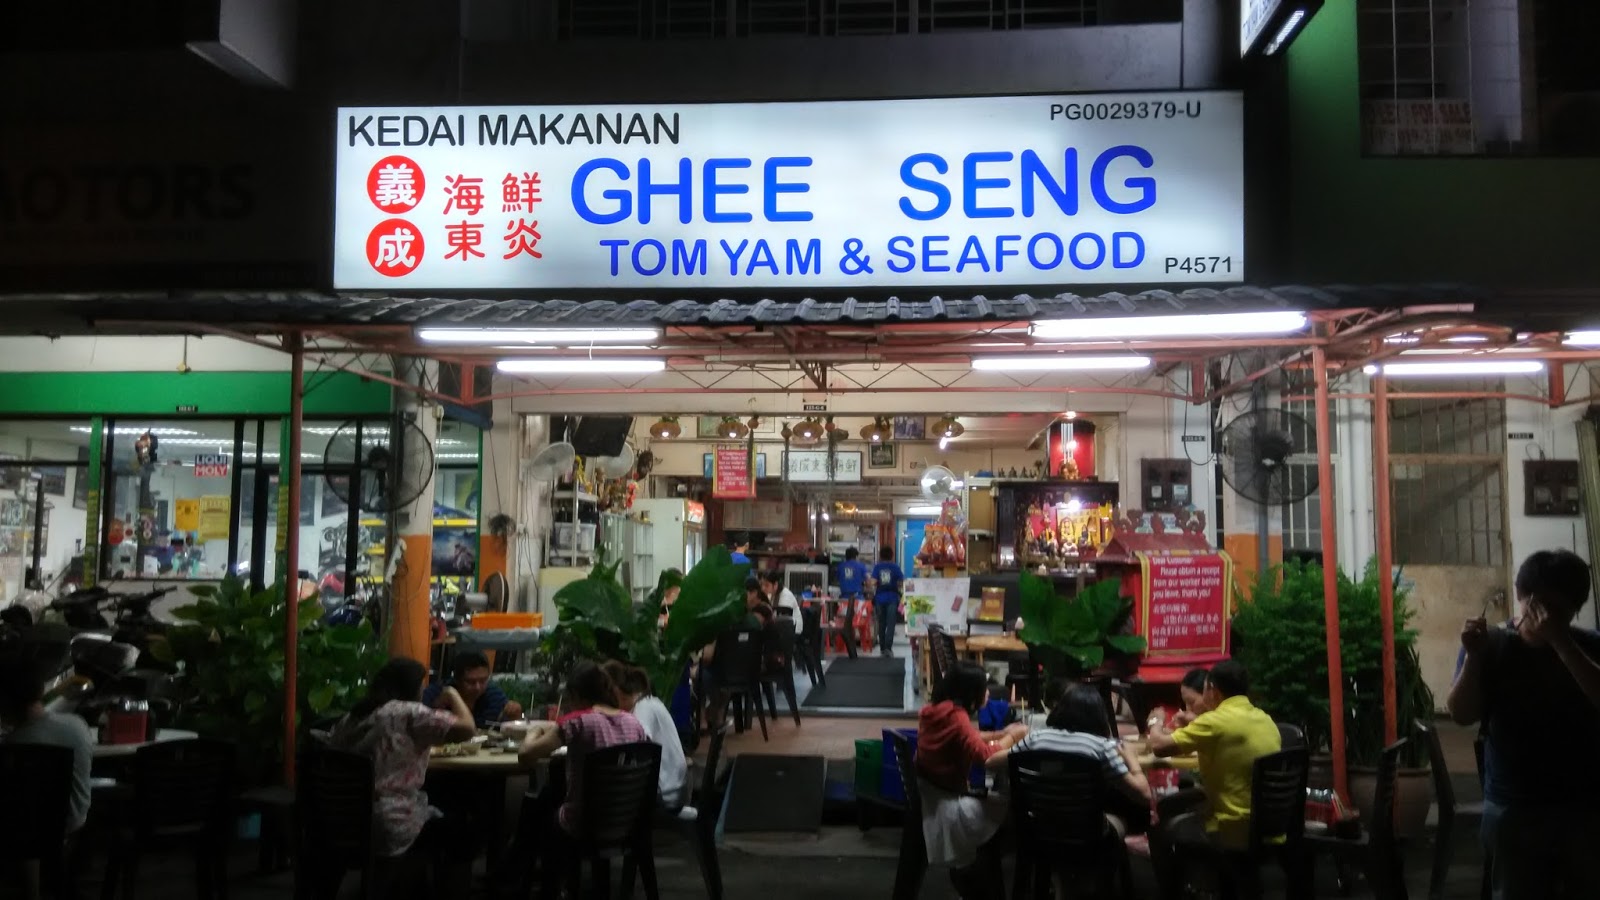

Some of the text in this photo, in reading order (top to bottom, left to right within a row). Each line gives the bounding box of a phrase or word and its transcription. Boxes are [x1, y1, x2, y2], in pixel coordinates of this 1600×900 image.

[1050, 100, 1203, 121] PG0029379-U
[349, 112, 680, 147] KEDAI MAKANAN
[570, 144, 1158, 226] GHEE SENG
[375, 163, 417, 268] 義成
[598, 230, 1146, 278] TOM YAM & SEAFOOD
[1164, 256, 1233, 274] P4571
[196, 455, 227, 464] LIQUI
[195, 464, 227, 477] MOLY
[1161, 567, 1178, 576] Please
[1179, 566, 1196, 576] obtain
[1202, 566, 1220, 578] receipt
[1154, 577, 1220, 588] from our worker before
[1153, 591, 1164, 601] you
[1181, 588, 1198, 598] thank
